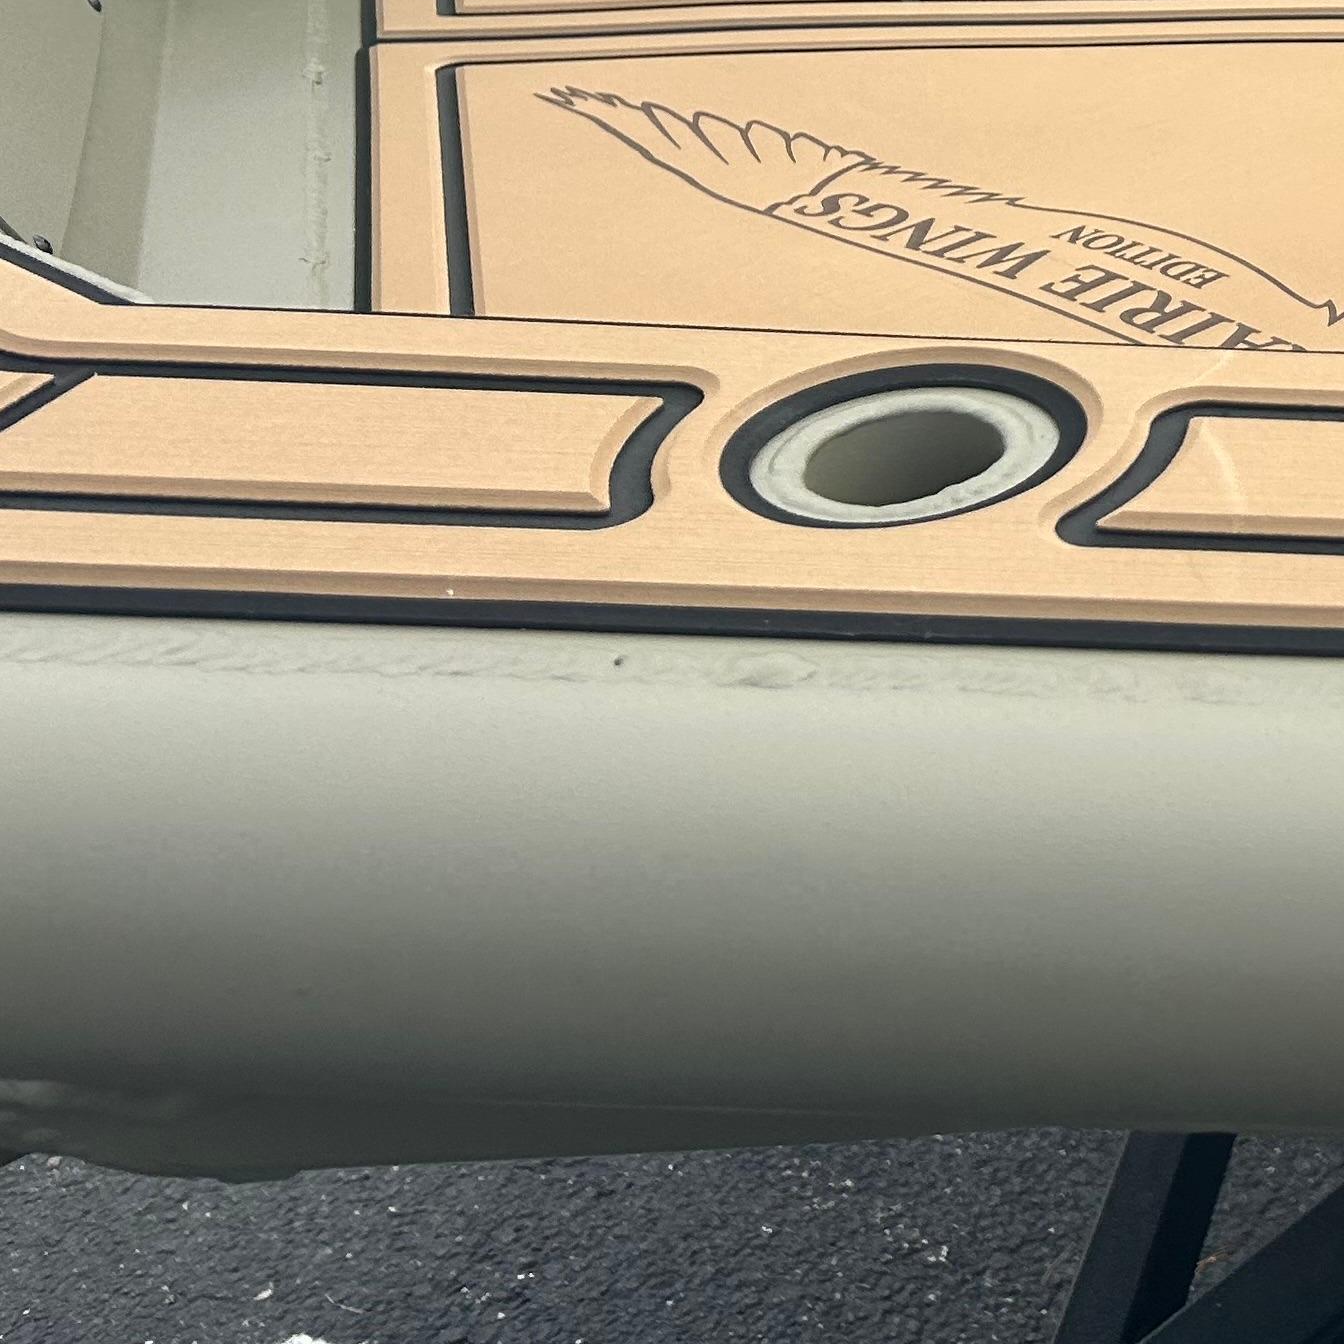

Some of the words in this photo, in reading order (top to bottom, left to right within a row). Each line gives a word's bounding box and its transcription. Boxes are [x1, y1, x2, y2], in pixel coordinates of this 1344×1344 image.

[795, 193, 1051, 280] WINGS
[1049, 224, 1231, 289] EDITION
[1040, 264, 1306, 352] AIRIE
